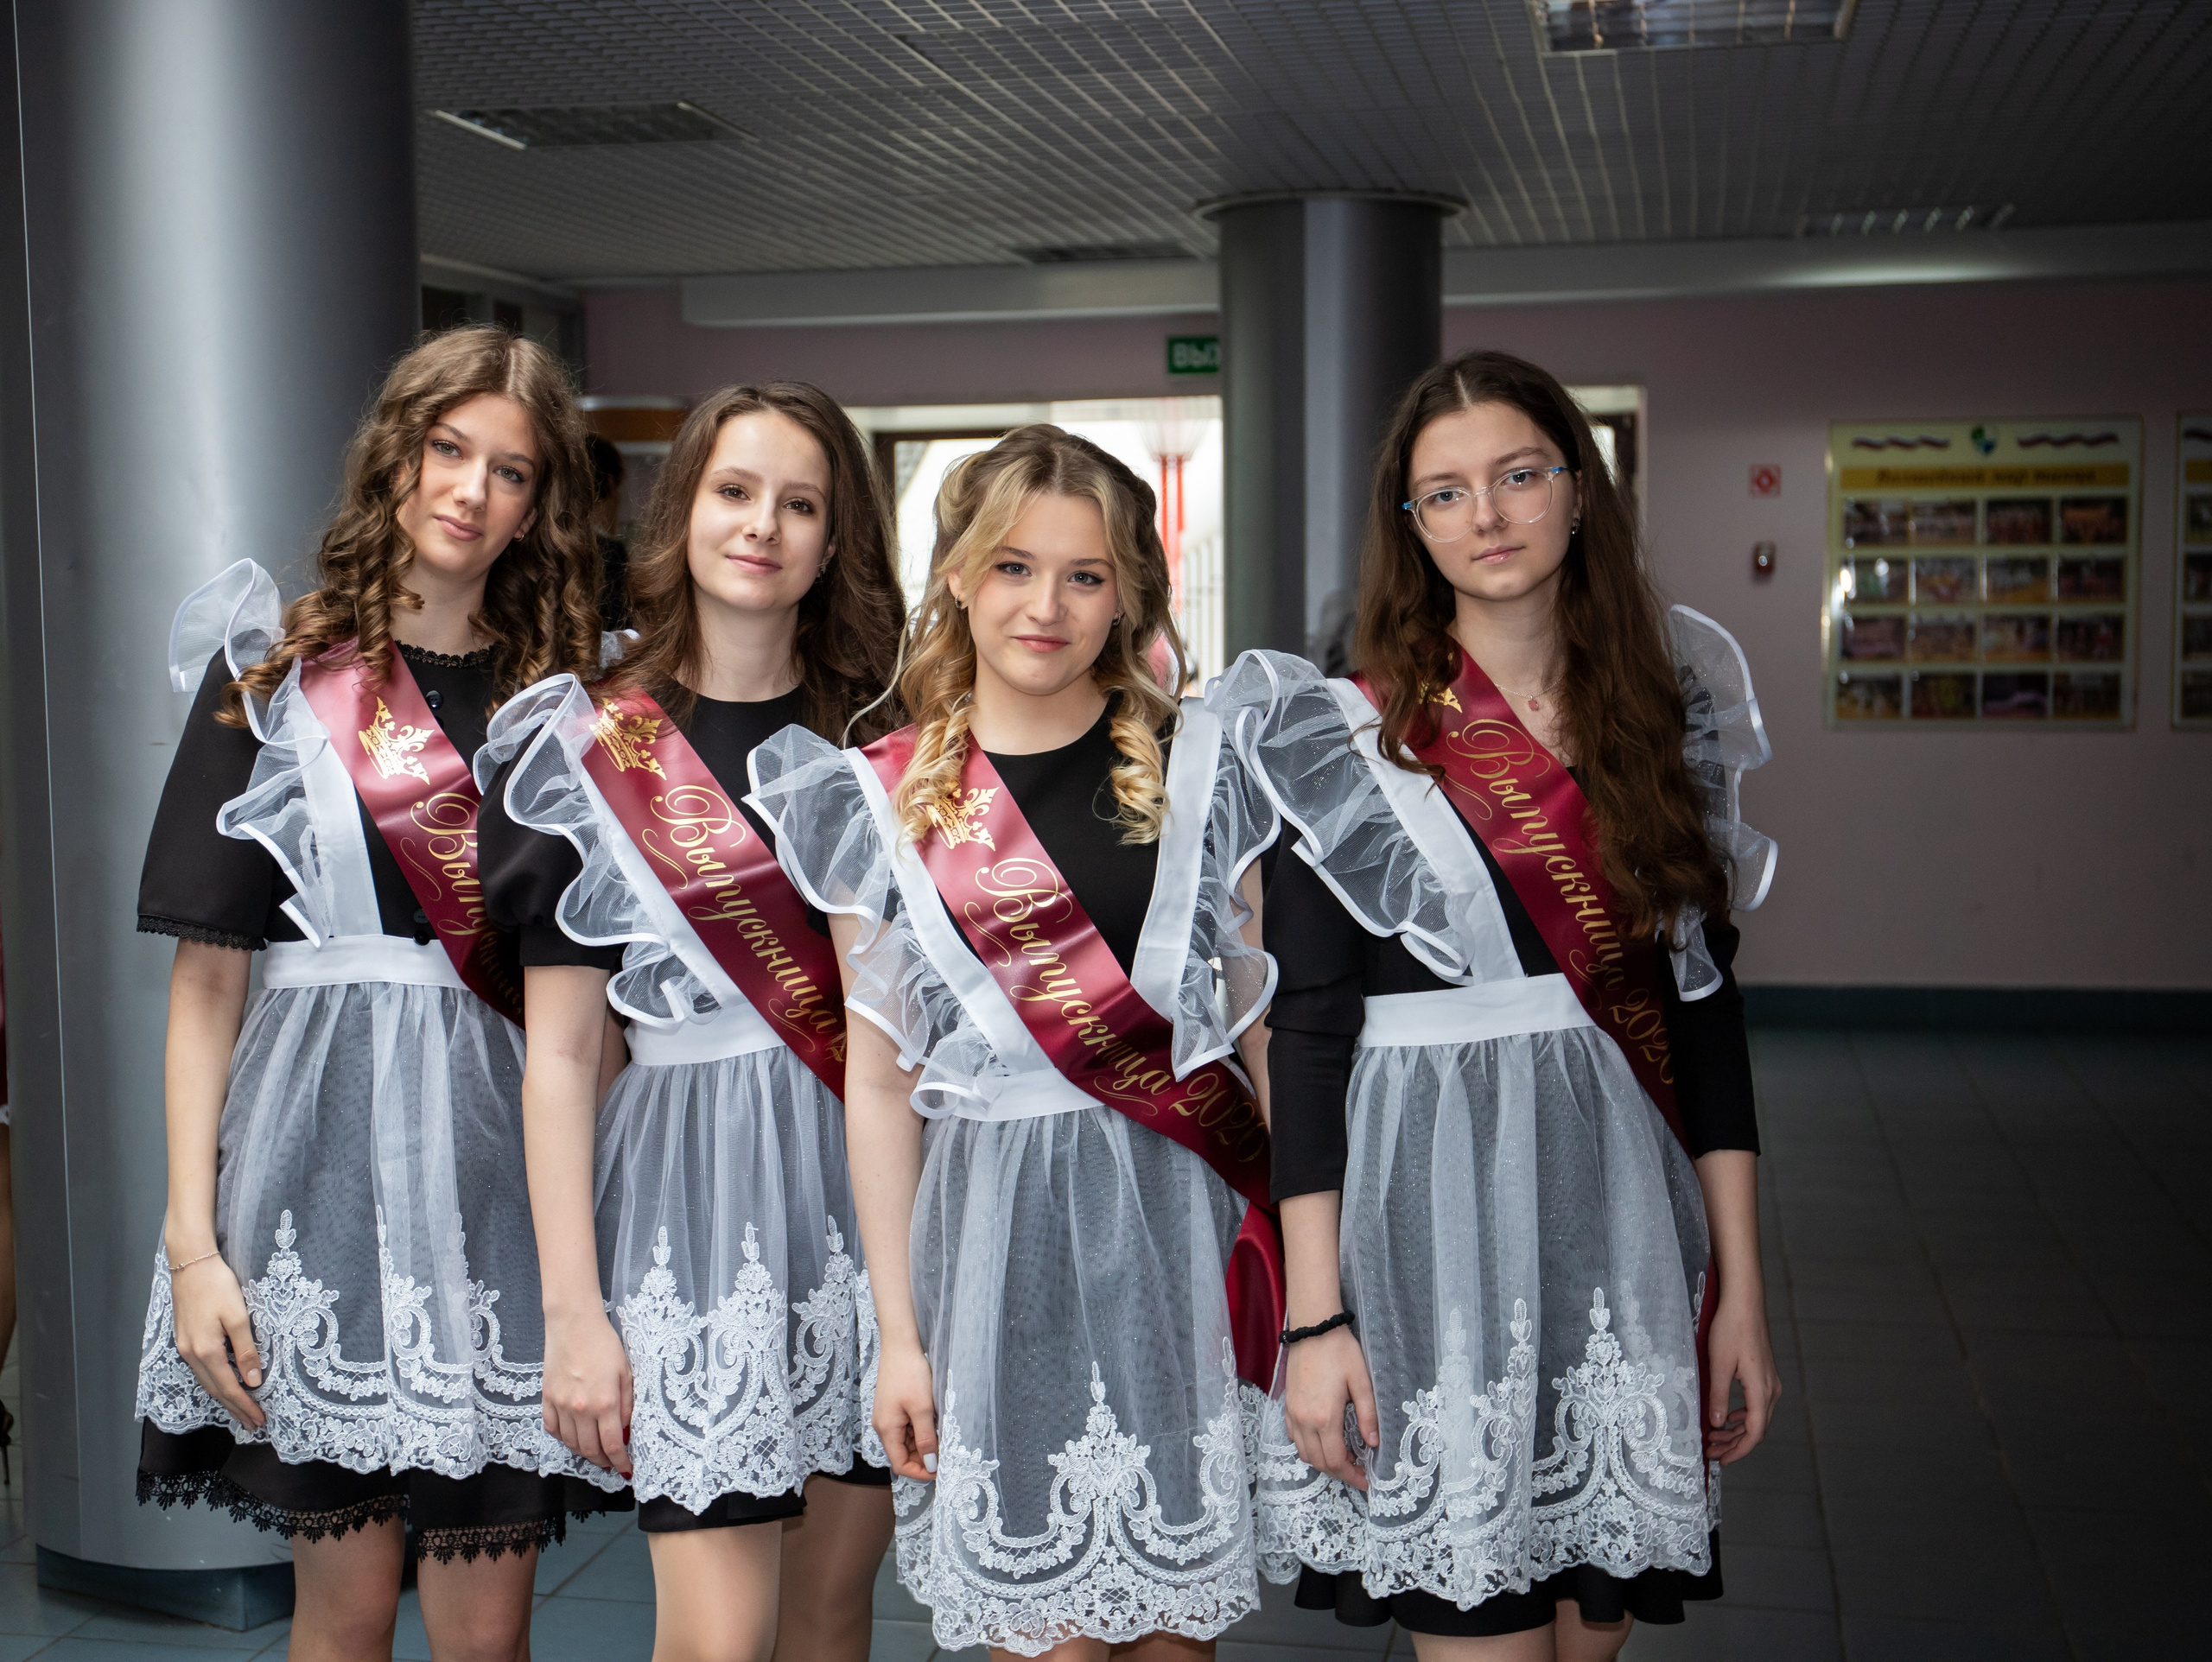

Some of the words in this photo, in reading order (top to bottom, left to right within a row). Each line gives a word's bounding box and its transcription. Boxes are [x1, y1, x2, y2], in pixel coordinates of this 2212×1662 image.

[642, 784, 838, 1051] Выпускница
[964, 858, 1171, 1115] Выпускница
[1441, 719, 1624, 1009] Выпускница
